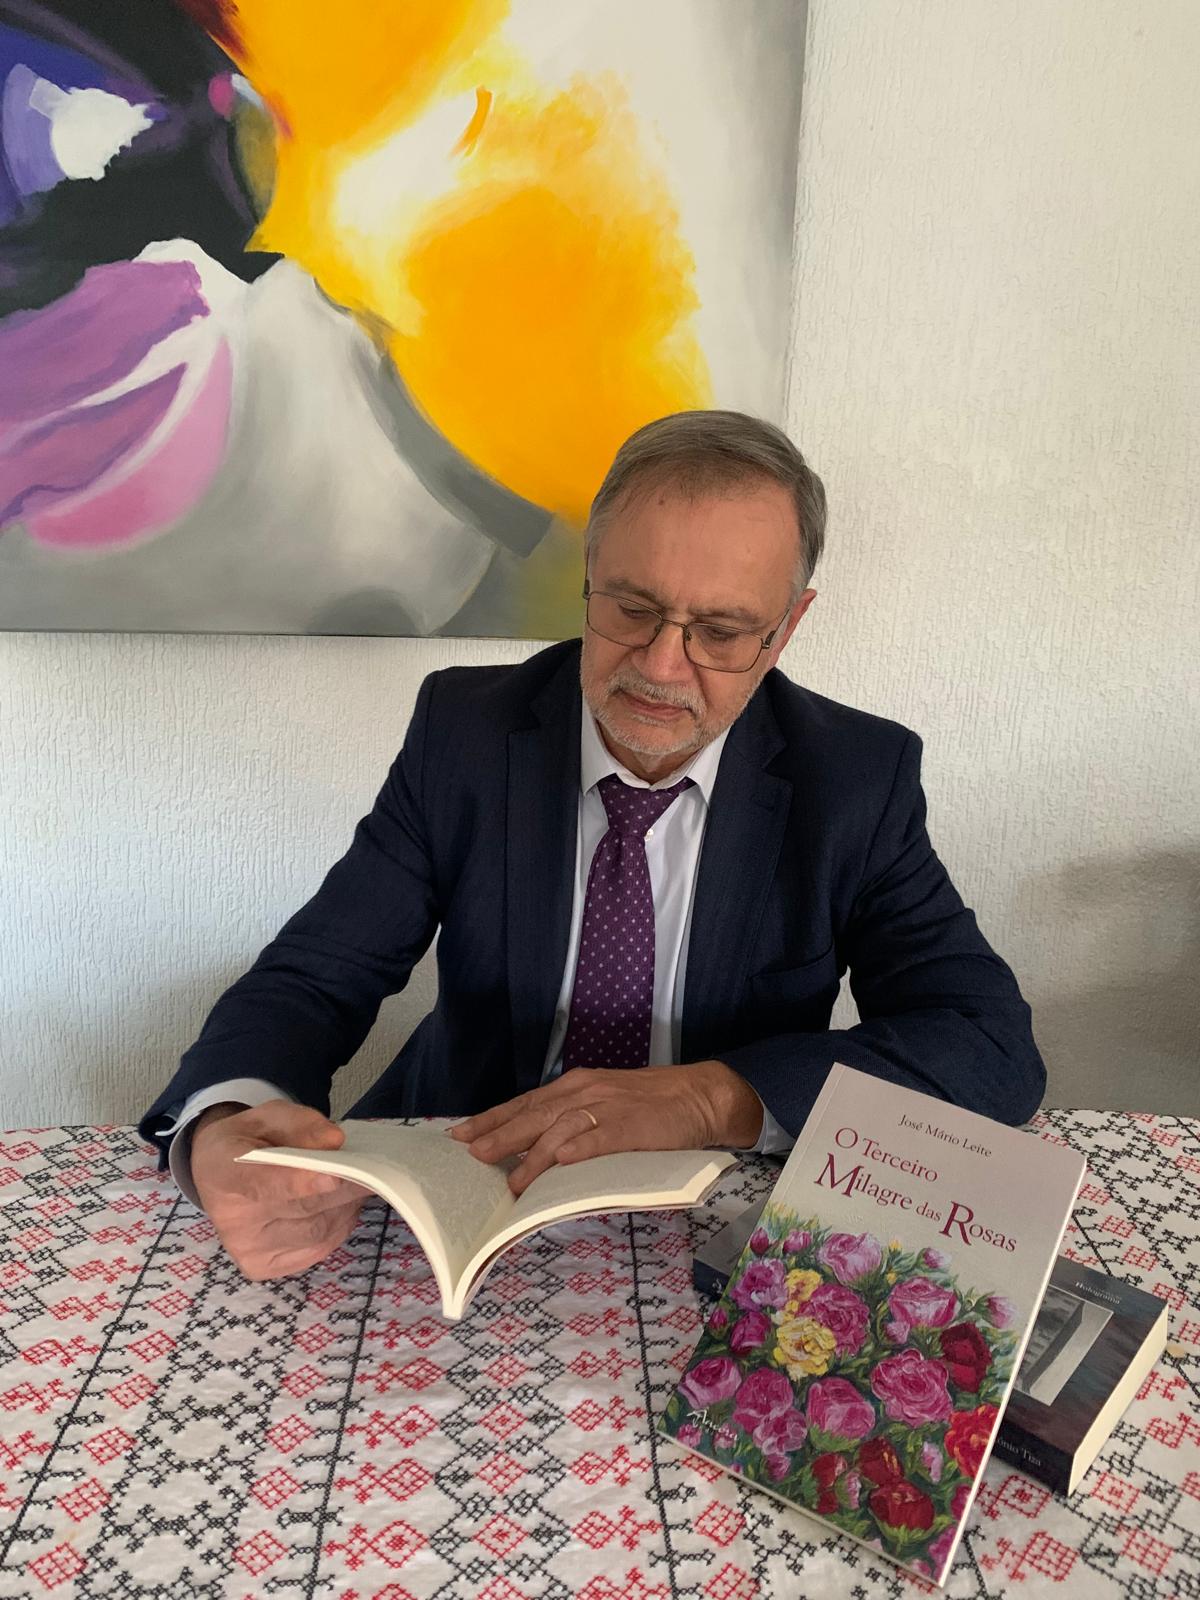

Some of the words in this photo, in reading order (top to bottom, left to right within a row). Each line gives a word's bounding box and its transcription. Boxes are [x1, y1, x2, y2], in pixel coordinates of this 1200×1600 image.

[835, 1127, 859, 1149] O
[862, 1137, 938, 1183] Terceiro
[898, 1114, 923, 1131] José
[925, 1124, 960, 1145] Mário
[962, 1138, 992, 1157] Leite
[813, 1152, 913, 1210] Milagre
[916, 1202, 942, 1221] das
[938, 1200, 1017, 1252] Rosas
